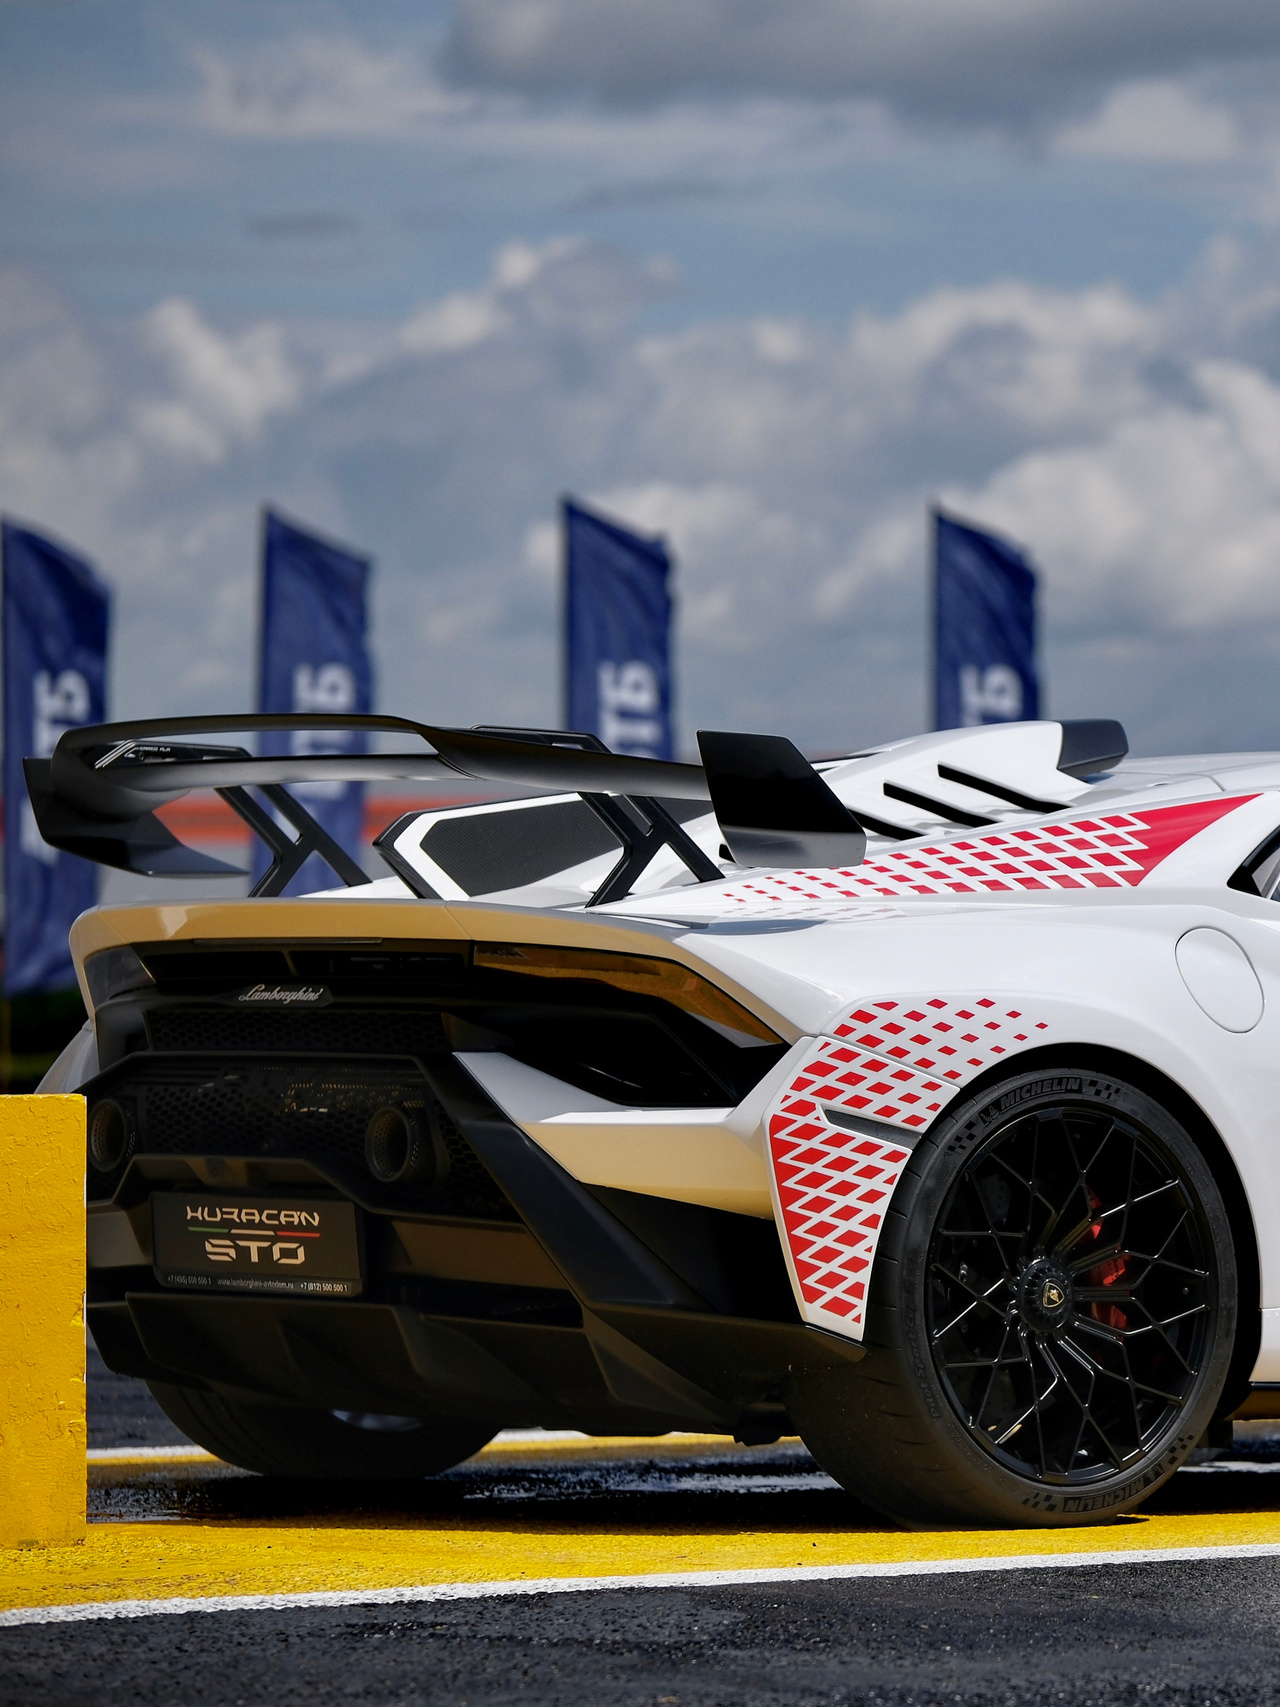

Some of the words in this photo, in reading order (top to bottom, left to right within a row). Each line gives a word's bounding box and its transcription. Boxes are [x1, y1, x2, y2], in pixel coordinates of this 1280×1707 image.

[600, 660, 661, 757] ТБ
[238, 983, 324, 1005] Lamborghini
[1000, 1078, 1082, 1110] MICHELIN
[204, 1238, 306, 1265] STO
[300, 1282, 308, 1290] +7
[308, 1282, 322, 1292] (812)
[322, 1283, 333, 1292] 500
[333, 1284, 343, 1292] 500
[1064, 1477, 1144, 1513] MICHELIN
